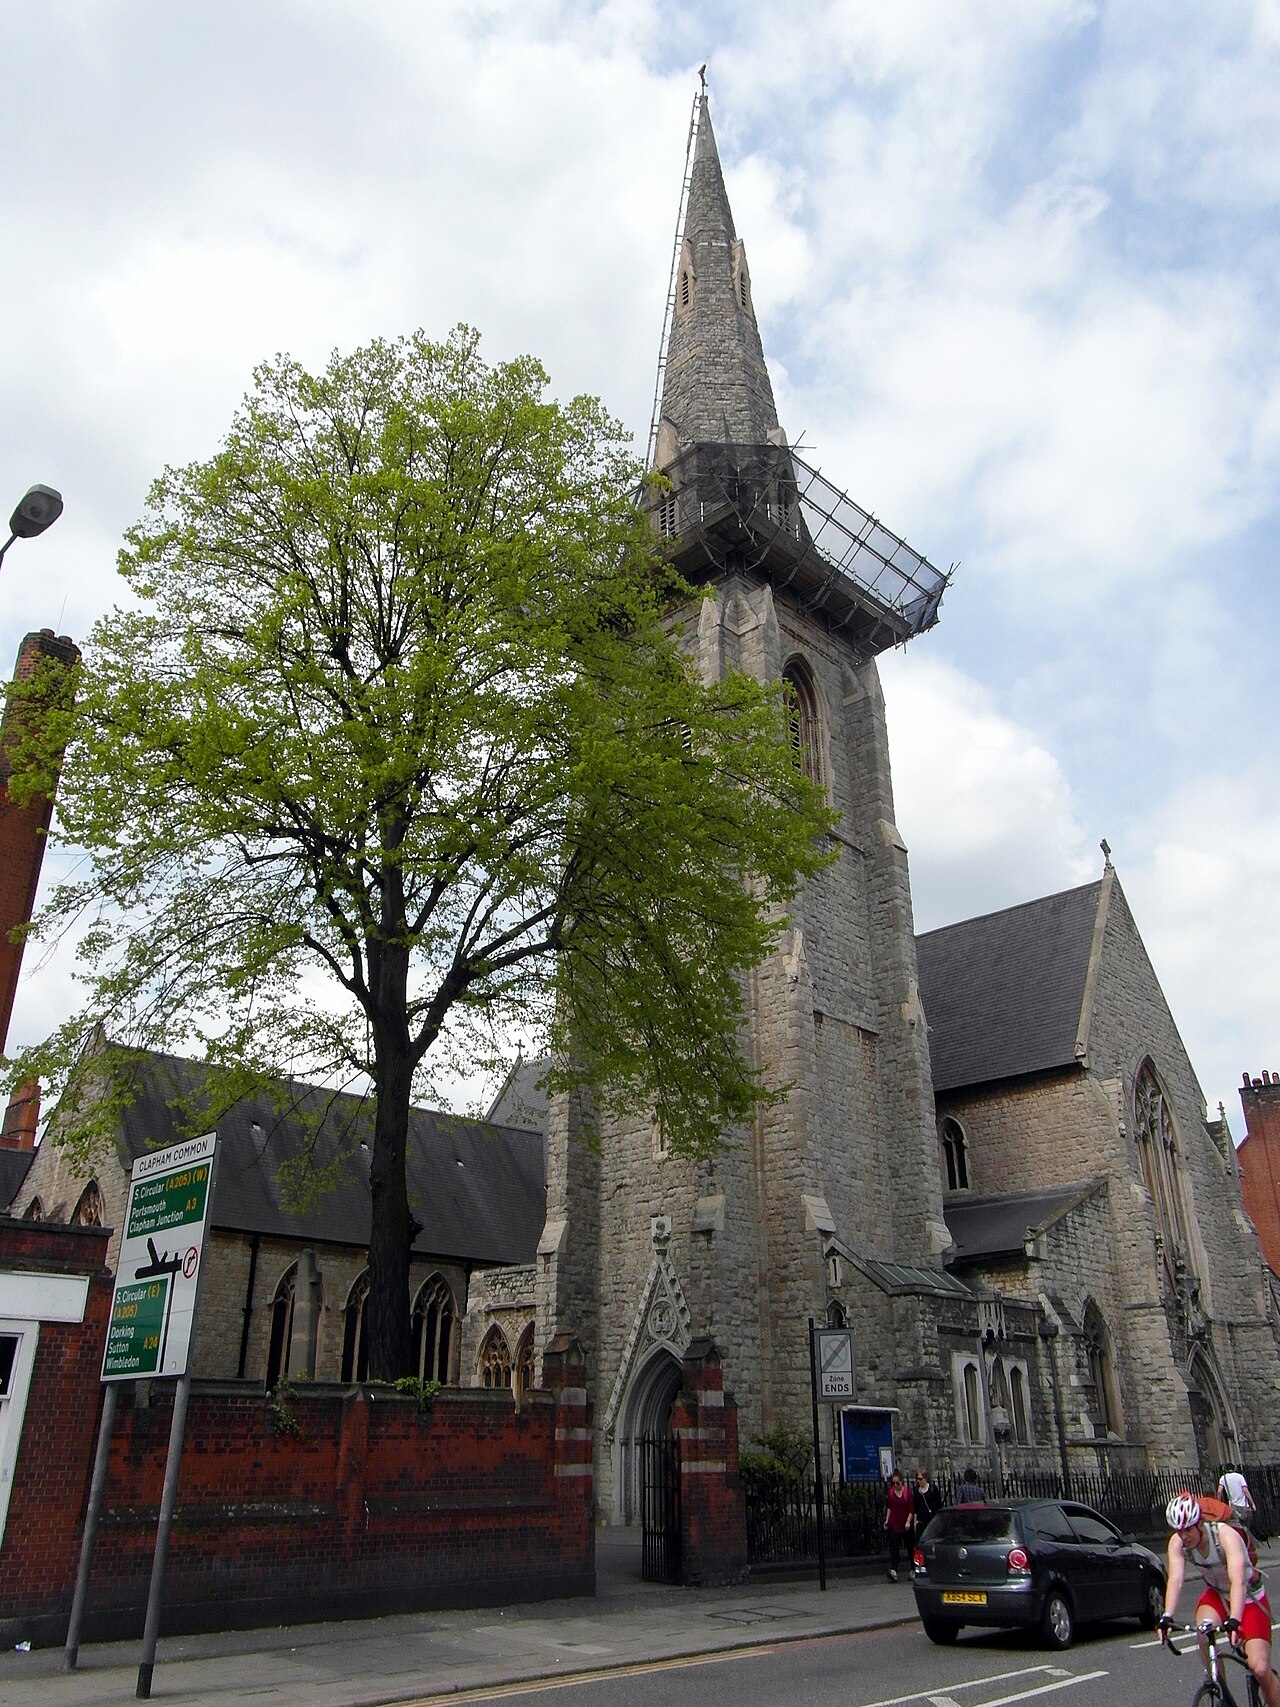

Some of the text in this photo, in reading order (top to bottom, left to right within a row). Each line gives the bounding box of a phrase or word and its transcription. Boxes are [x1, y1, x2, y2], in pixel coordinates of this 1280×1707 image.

[139, 1140, 208, 1172] CLAPHAM COMMON
[193, 1167, 207, 1184] (W)
[131, 1199, 167, 1219] Portsmouth
[185, 1197, 198, 1211] A3
[129, 1210, 184, 1233] Clapham Junction
[110, 1325, 135, 1339] Dorking
[108, 1341, 130, 1354] Sutton
[143, 1335, 159, 1350] A24
[106, 1355, 140, 1370] Wimbledon
[825, 1384, 850, 1392] ENDS
